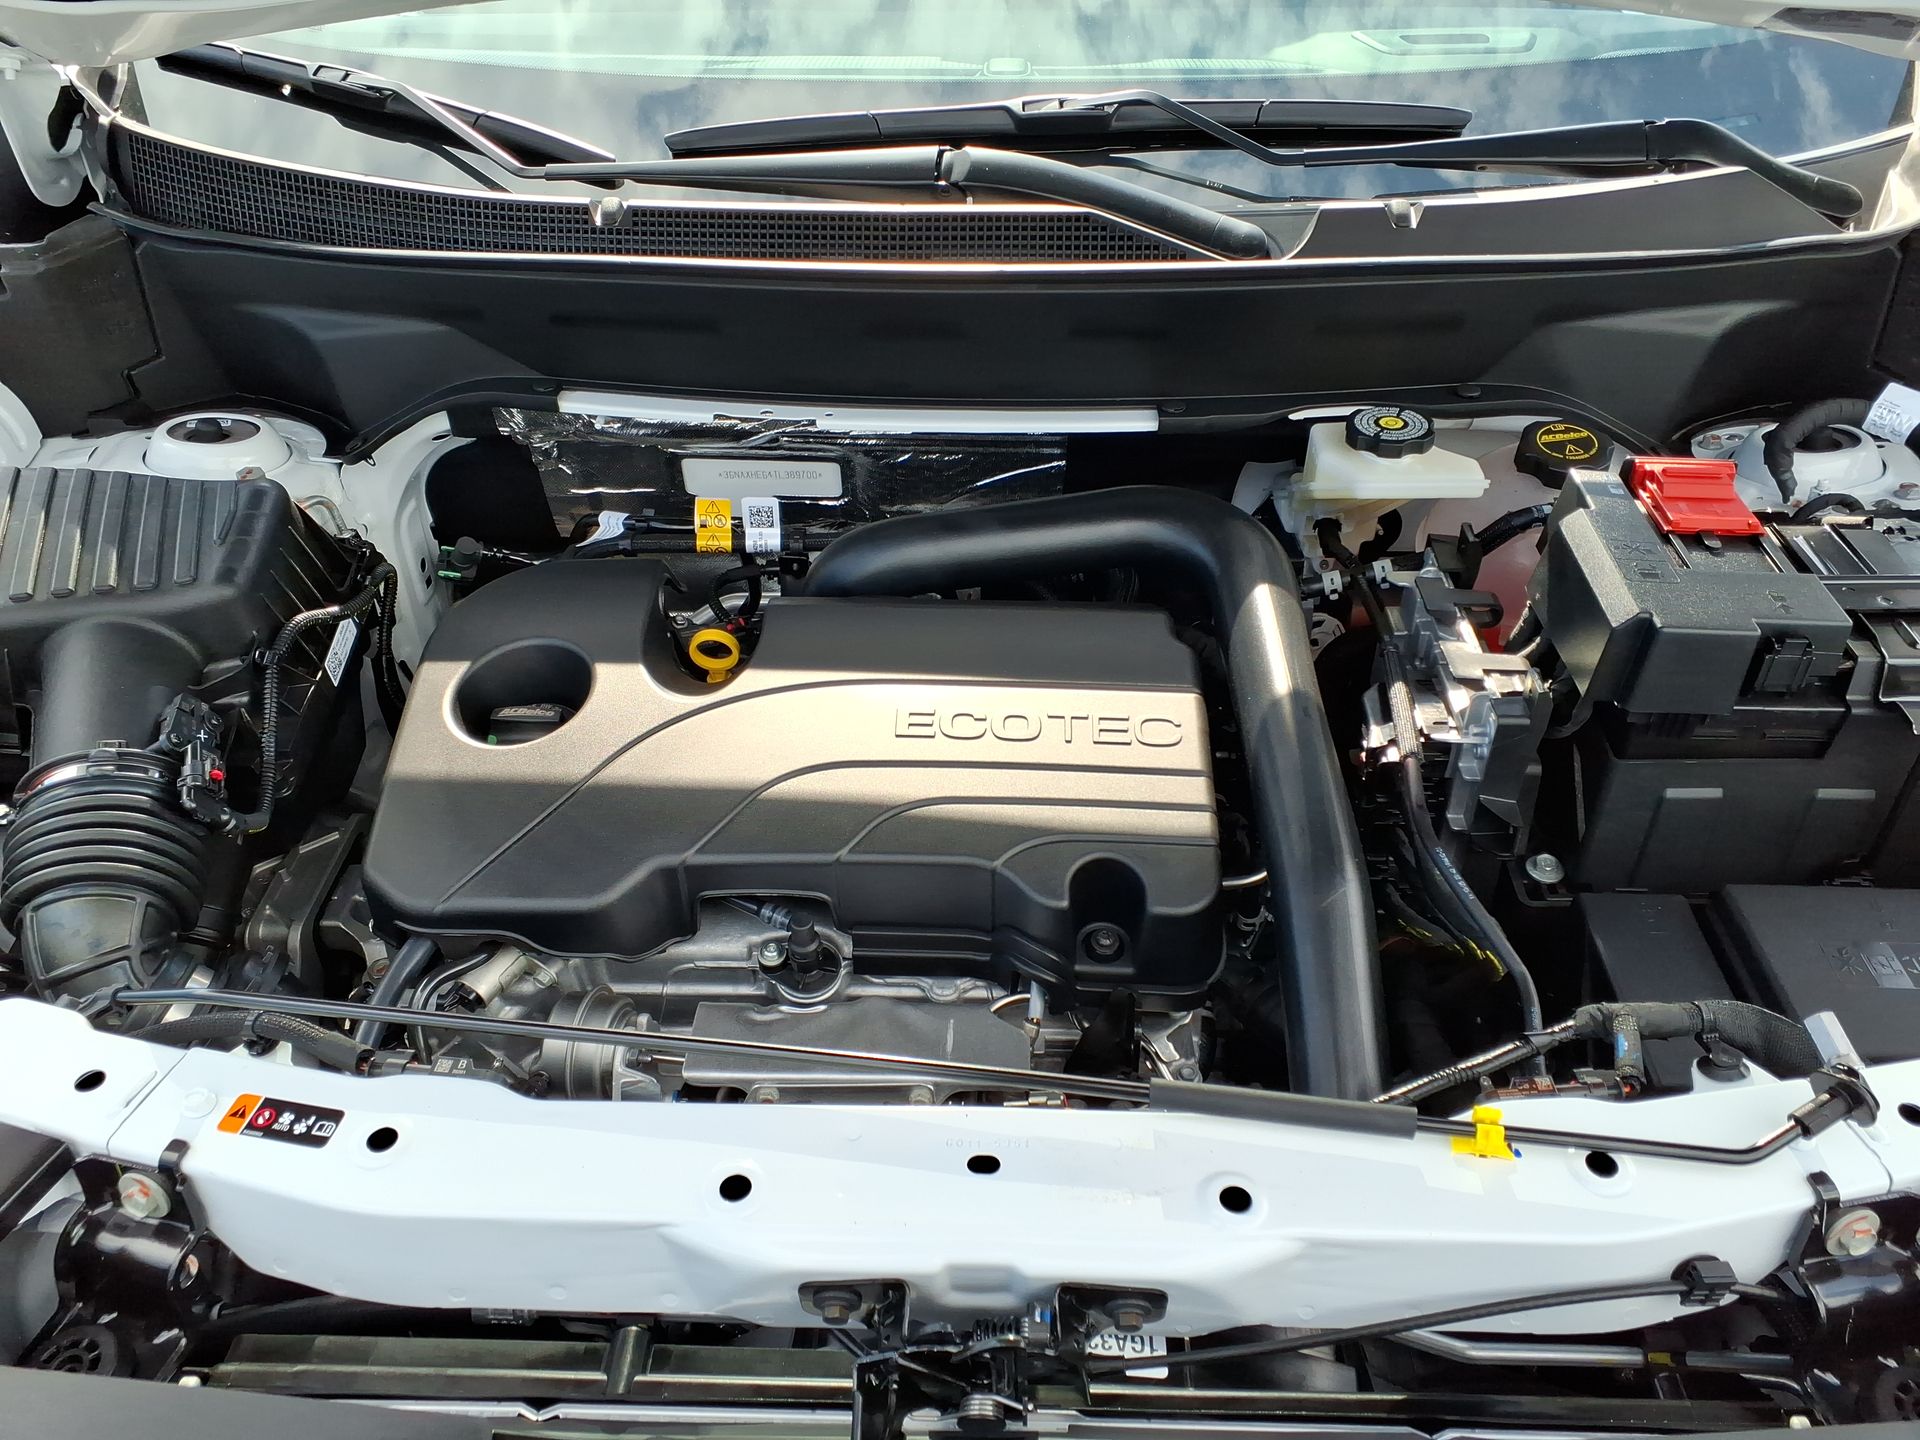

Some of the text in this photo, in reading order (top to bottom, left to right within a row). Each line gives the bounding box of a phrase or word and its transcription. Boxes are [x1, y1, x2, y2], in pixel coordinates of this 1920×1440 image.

[1541, 432, 1588, 443] ACDelco
[498, 707, 555, 717] ACDelco
[895, 708, 1183, 748] ECOTEC
[457, 1060, 467, 1069] B
[271, 1122, 290, 1132] AUTO
